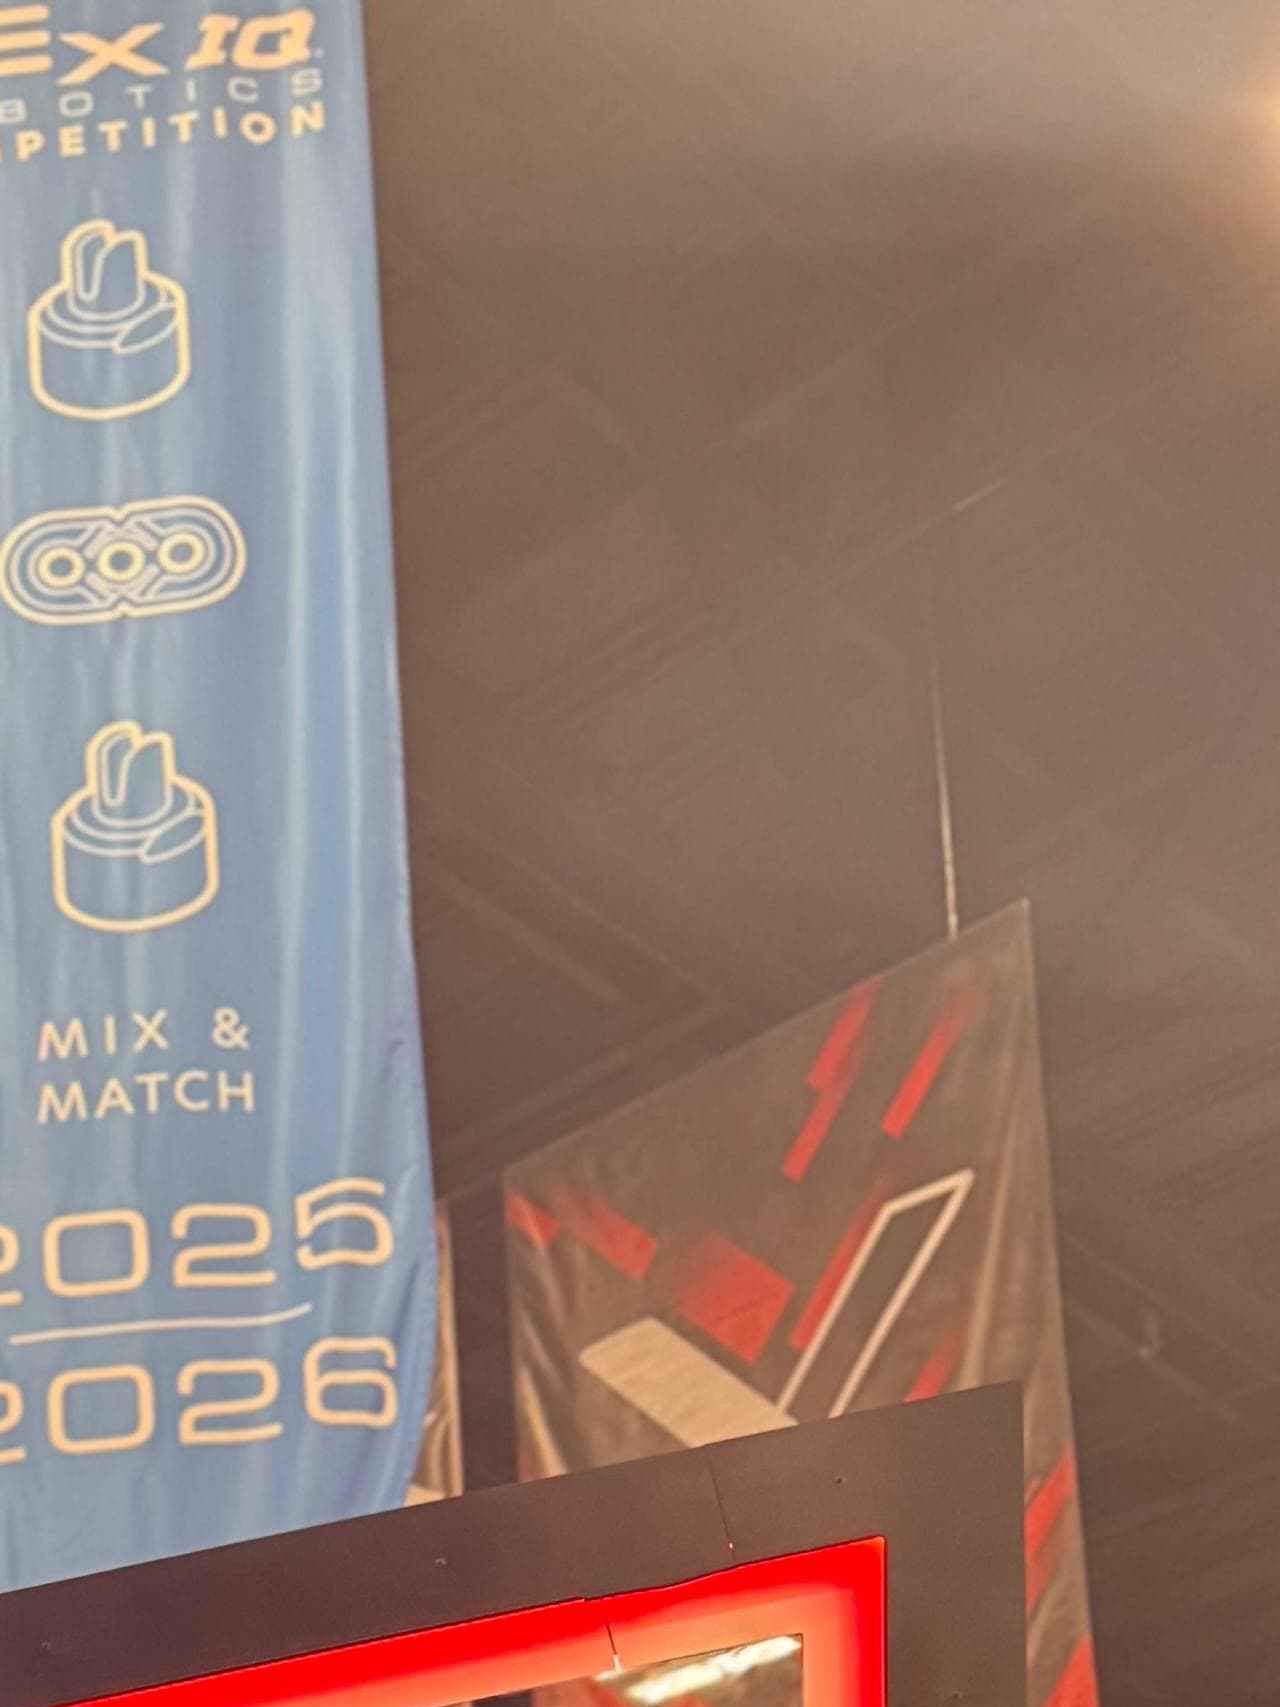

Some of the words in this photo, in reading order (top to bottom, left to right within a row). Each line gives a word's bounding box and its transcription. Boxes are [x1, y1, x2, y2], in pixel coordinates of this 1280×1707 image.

[184, 9, 316, 72] IQ
[38, 1009, 169, 1062] MIX
[211, 1007, 250, 1050] &
[37, 1070, 256, 1124] MATCH
